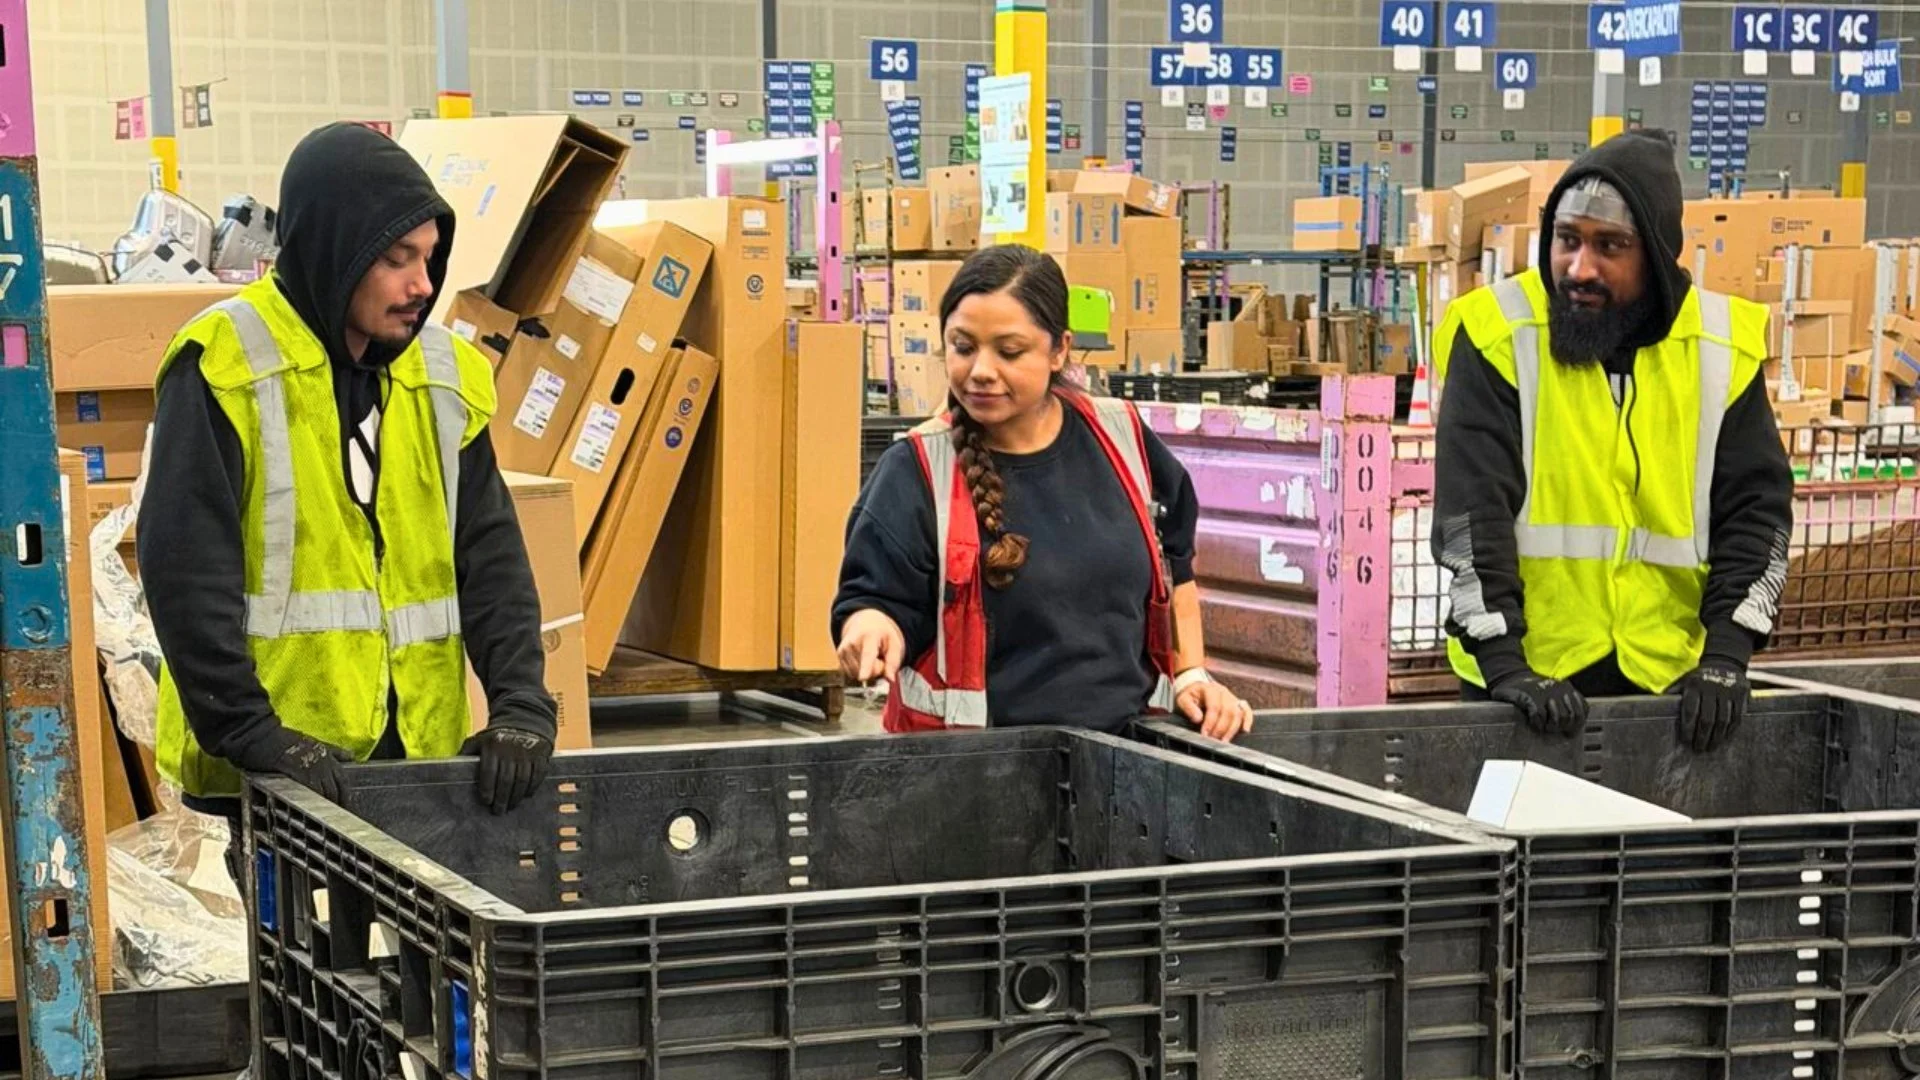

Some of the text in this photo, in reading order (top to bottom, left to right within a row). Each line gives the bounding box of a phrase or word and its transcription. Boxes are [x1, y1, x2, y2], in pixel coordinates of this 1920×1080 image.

[1180, 3, 1213, 34] 36
[1391, 7, 1424, 37] 40
[1454, 9, 1483, 38] 41
[1597, 12, 1626, 41] 42
[1743, 13, 1772, 43] 1C
[1791, 14, 1822, 43] 3C
[1838, 14, 1869, 44] 4C
[880, 47, 909, 73] 56
[1159, 54, 1186, 79] 57
[1204, 53, 1232, 79] 58
[1247, 55, 1274, 80] 55
[1502, 58, 1529, 83] 60
[1874, 48, 1897, 67] BULK
[1863, 69, 1886, 88] SORT
